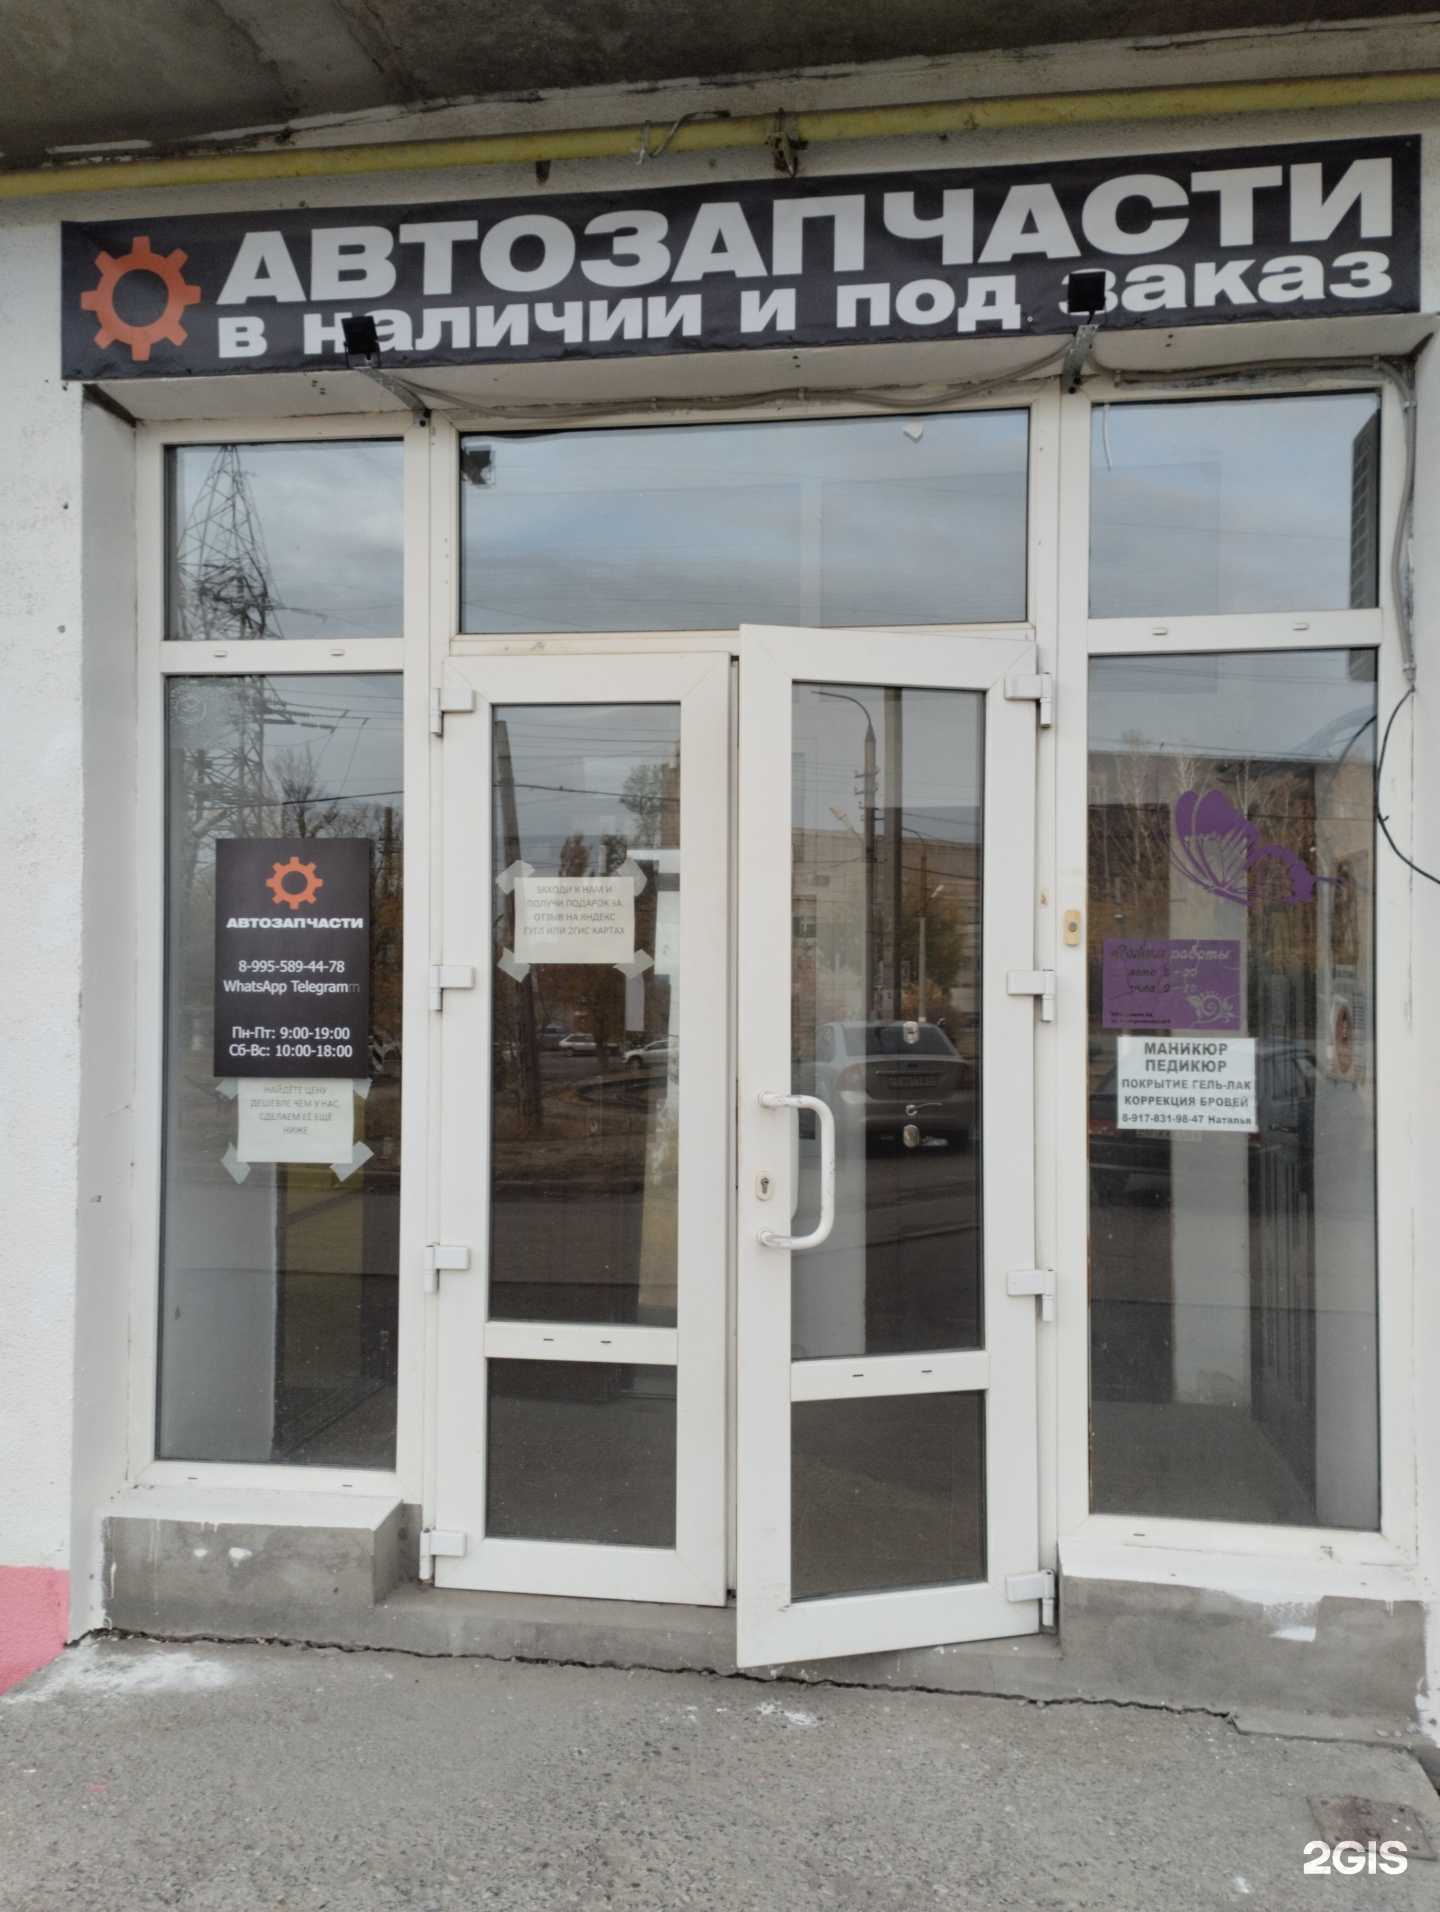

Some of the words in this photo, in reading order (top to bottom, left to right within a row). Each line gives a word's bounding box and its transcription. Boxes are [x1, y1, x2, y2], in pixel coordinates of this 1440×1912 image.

[216, 157, 1392, 305] АВТОЗАПЧАСТИ
[218, 317, 267, 359] в
[303, 294, 702, 356] наличии
[740, 288, 796, 333] и
[836, 275, 1021, 333] под
[226, 917, 364, 929] АВТОЗАПЧАСТИ
[238, 960, 345, 973] 8-995-589-44-78
[223, 979, 287, 995] WhatsApp
[232, 1026, 276, 1039] Пн-Пт:
[280, 1026, 350, 1040] 9:00-19:00
[229, 1045, 270, 1057] Сб-Вс:
[275, 1045, 353, 1058] 10:00-18:00
[1144, 1043, 1228, 1055] МАНИКЮР
[1145, 1060, 1226, 1073] ПЕДИКЮР
[1122, 1079, 1187, 1089] ПОКРЫТИЕ
[1192, 1080, 1251, 1090] ГЕЛЬ-ЛАК
[1125, 1096, 1195, 1107] КОРРЕКЦИЯ
[1200, 1096, 1248, 1107] БРОВЕЙ
